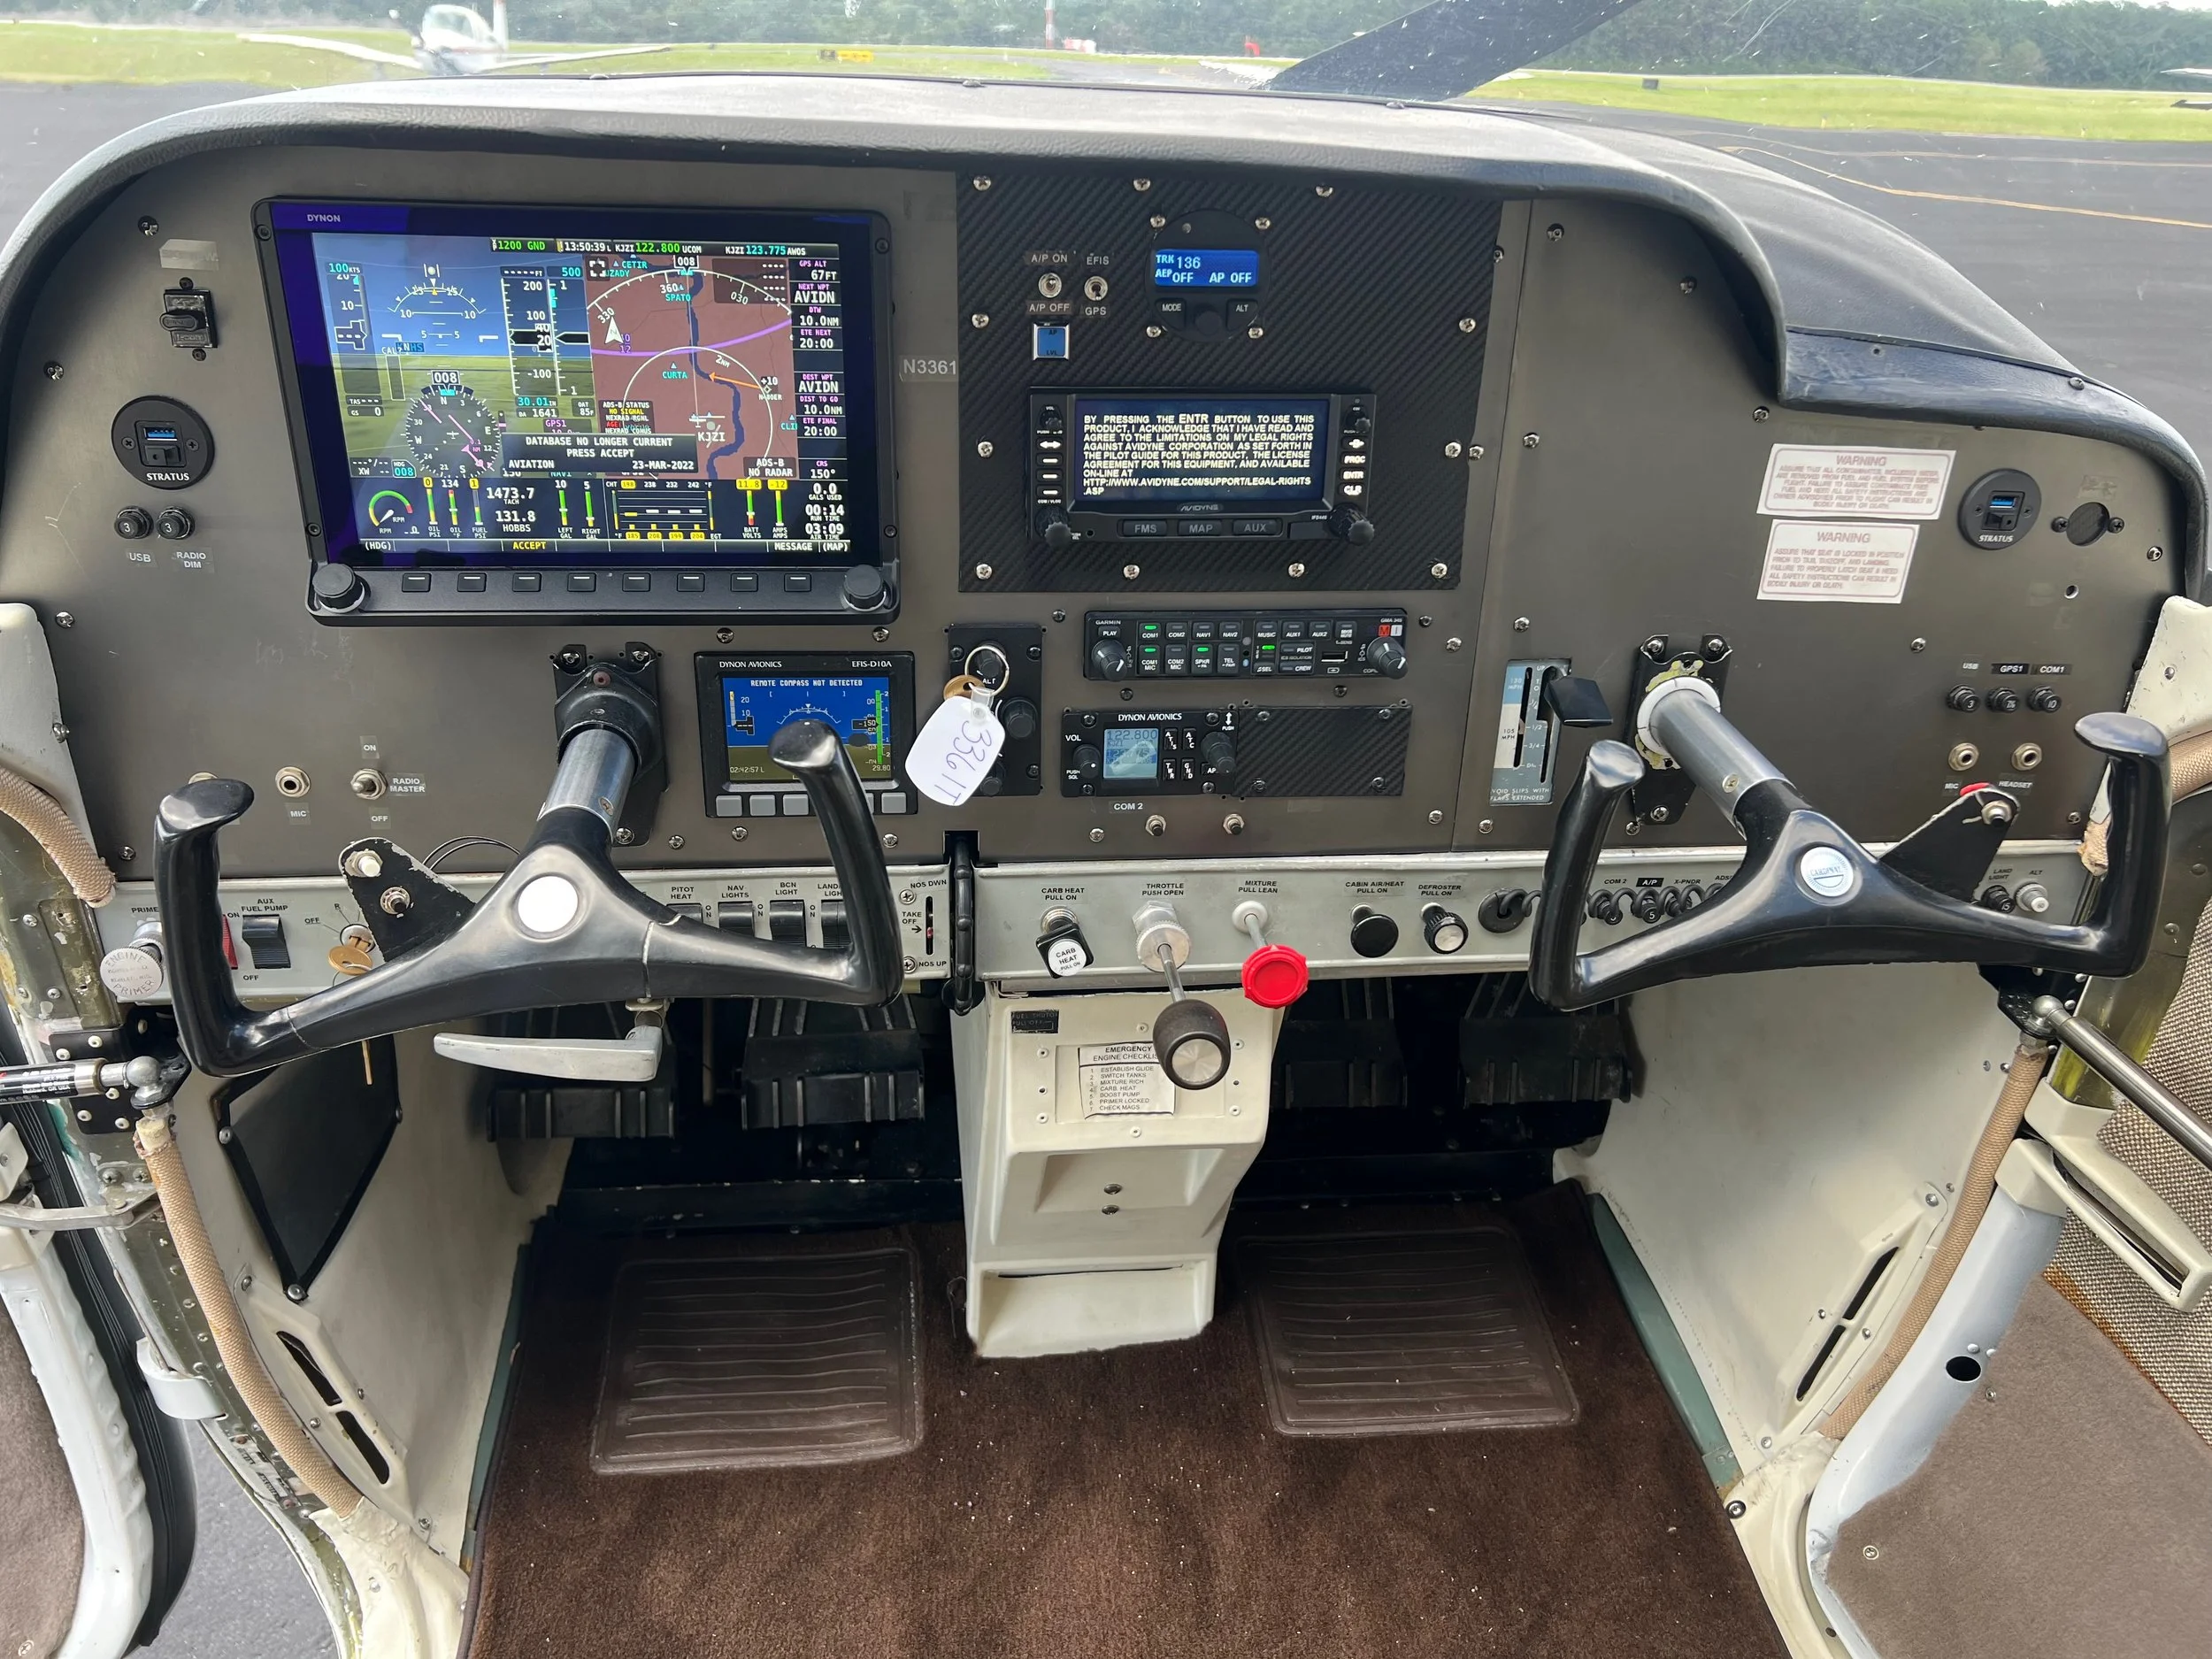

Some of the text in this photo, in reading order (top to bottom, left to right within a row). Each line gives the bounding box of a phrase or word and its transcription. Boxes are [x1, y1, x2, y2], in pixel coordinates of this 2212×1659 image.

[498, 241, 521, 250] 1200
[635, 242, 680, 253] 122.800
[746, 246, 786, 255] 123.775
[1032, 254, 1048, 263] A/P
[1087, 257, 1109, 265] EFIS
[1156, 255, 1200, 268] TRK 136
[562, 267, 580, 277] 500
[1172, 273, 1251, 282] OFF AP OFF
[795, 291, 834, 303] AVIDN
[1029, 303, 1045, 312] A/P
[800, 338, 833, 349] 20:00
[903, 359, 956, 375] N3361
[799, 381, 838, 393] AVIDN
[1179, 414, 1209, 423] ENTR
[698, 432, 726, 442] KJZI
[526, 437, 672, 447] DATABASE NO LONGER CURRENT
[566, 449, 634, 457] PRESS ACCEPT
[509, 460, 554, 469] AVIATION
[633, 461, 694, 470] 23-MAR-2022
[757, 458, 784, 467] ADS-B
[1837, 456, 1886, 466] WARNING
[487, 488, 534, 499] 1473.7
[495, 511, 535, 522] 131.8
[503, 524, 531, 533] HOBBS
[1135, 525, 1156, 534] FMS
[1189, 524, 1213, 533] MAP
[1817, 532, 1870, 543] WARNING
[823, 542, 848, 551] (MAP)
[129, 553, 150, 562] USB
